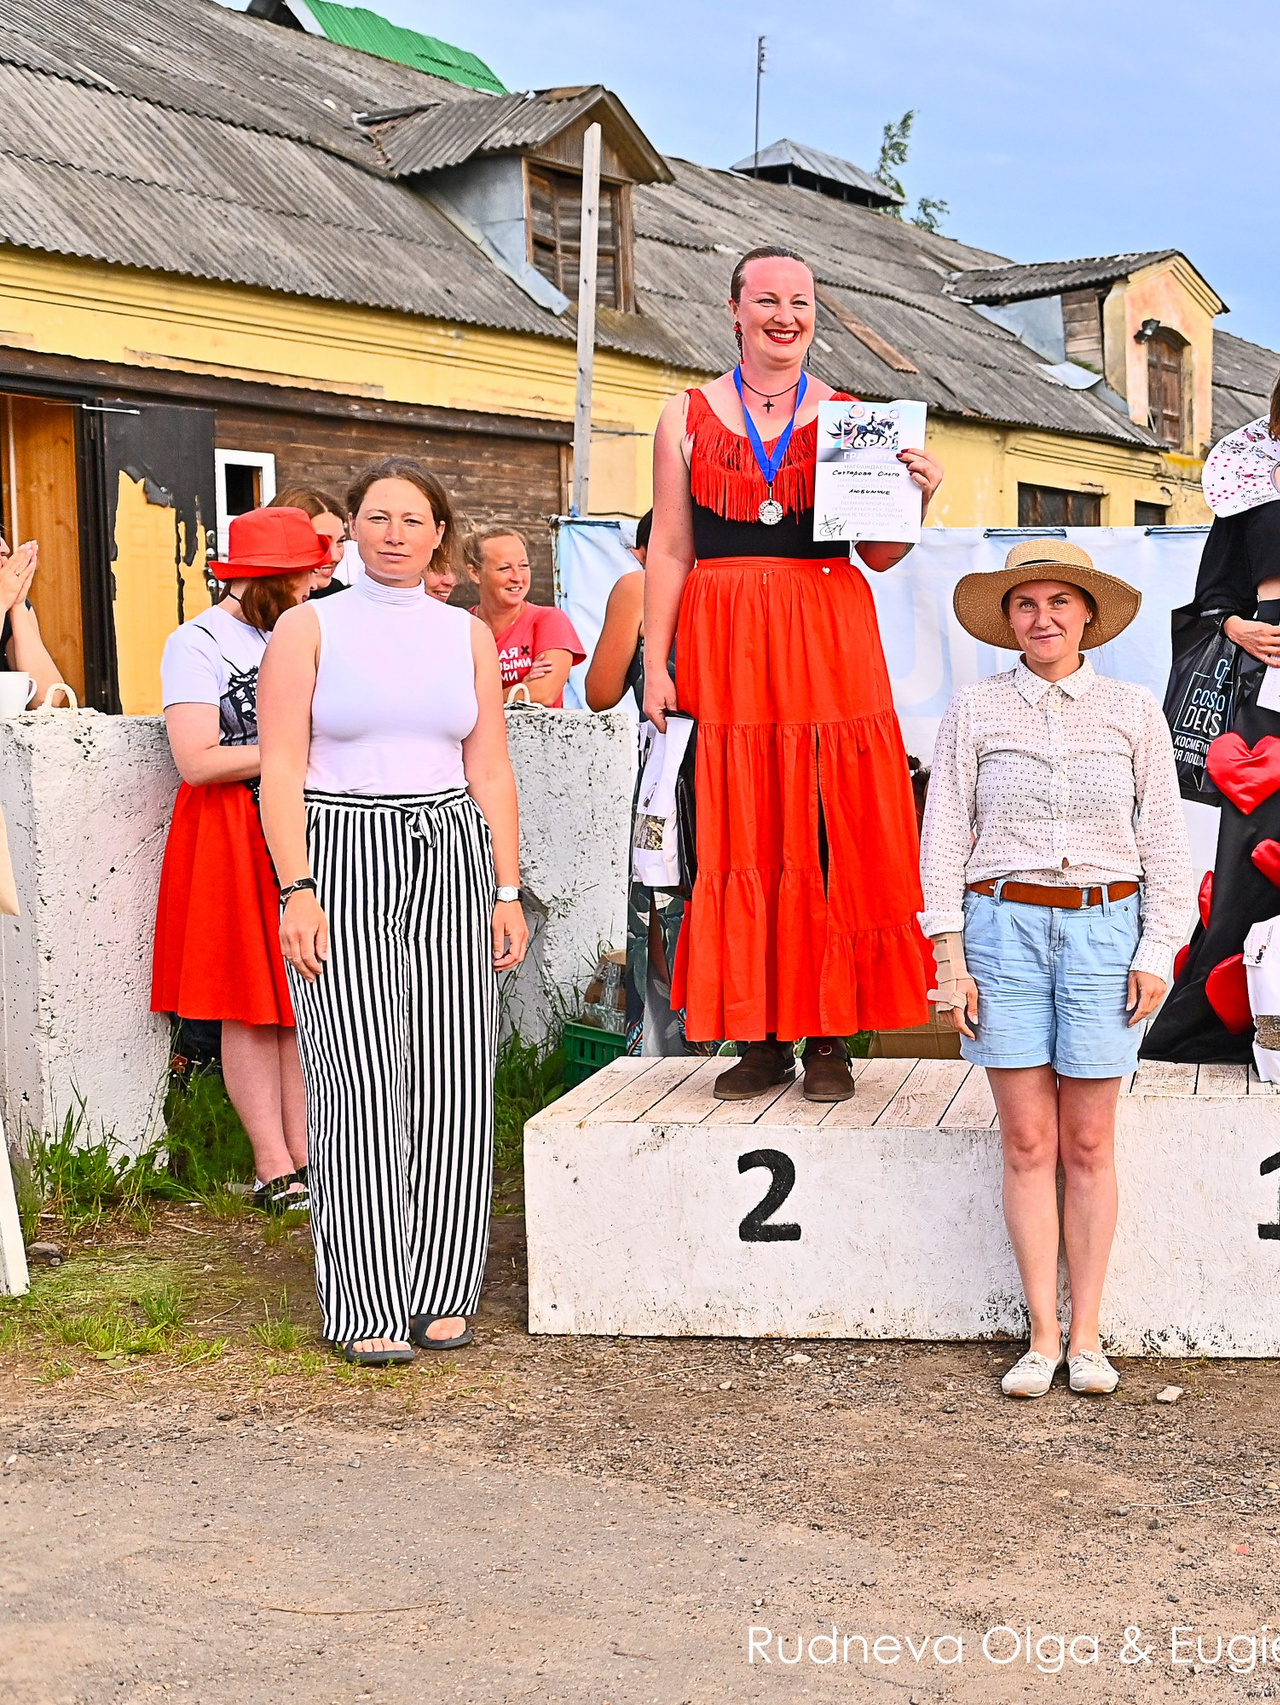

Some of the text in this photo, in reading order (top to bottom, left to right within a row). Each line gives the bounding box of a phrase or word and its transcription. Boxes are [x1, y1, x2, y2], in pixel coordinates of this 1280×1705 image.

[499, 647, 519, 660] АЯ
[500, 657, 532, 671] ЫМИ
[1191, 687, 1226, 712] COSO
[1172, 734, 1210, 755] КОСМЕТИ
[1182, 751, 1207, 769] ЛОША
[737, 1149, 802, 1243] 2
